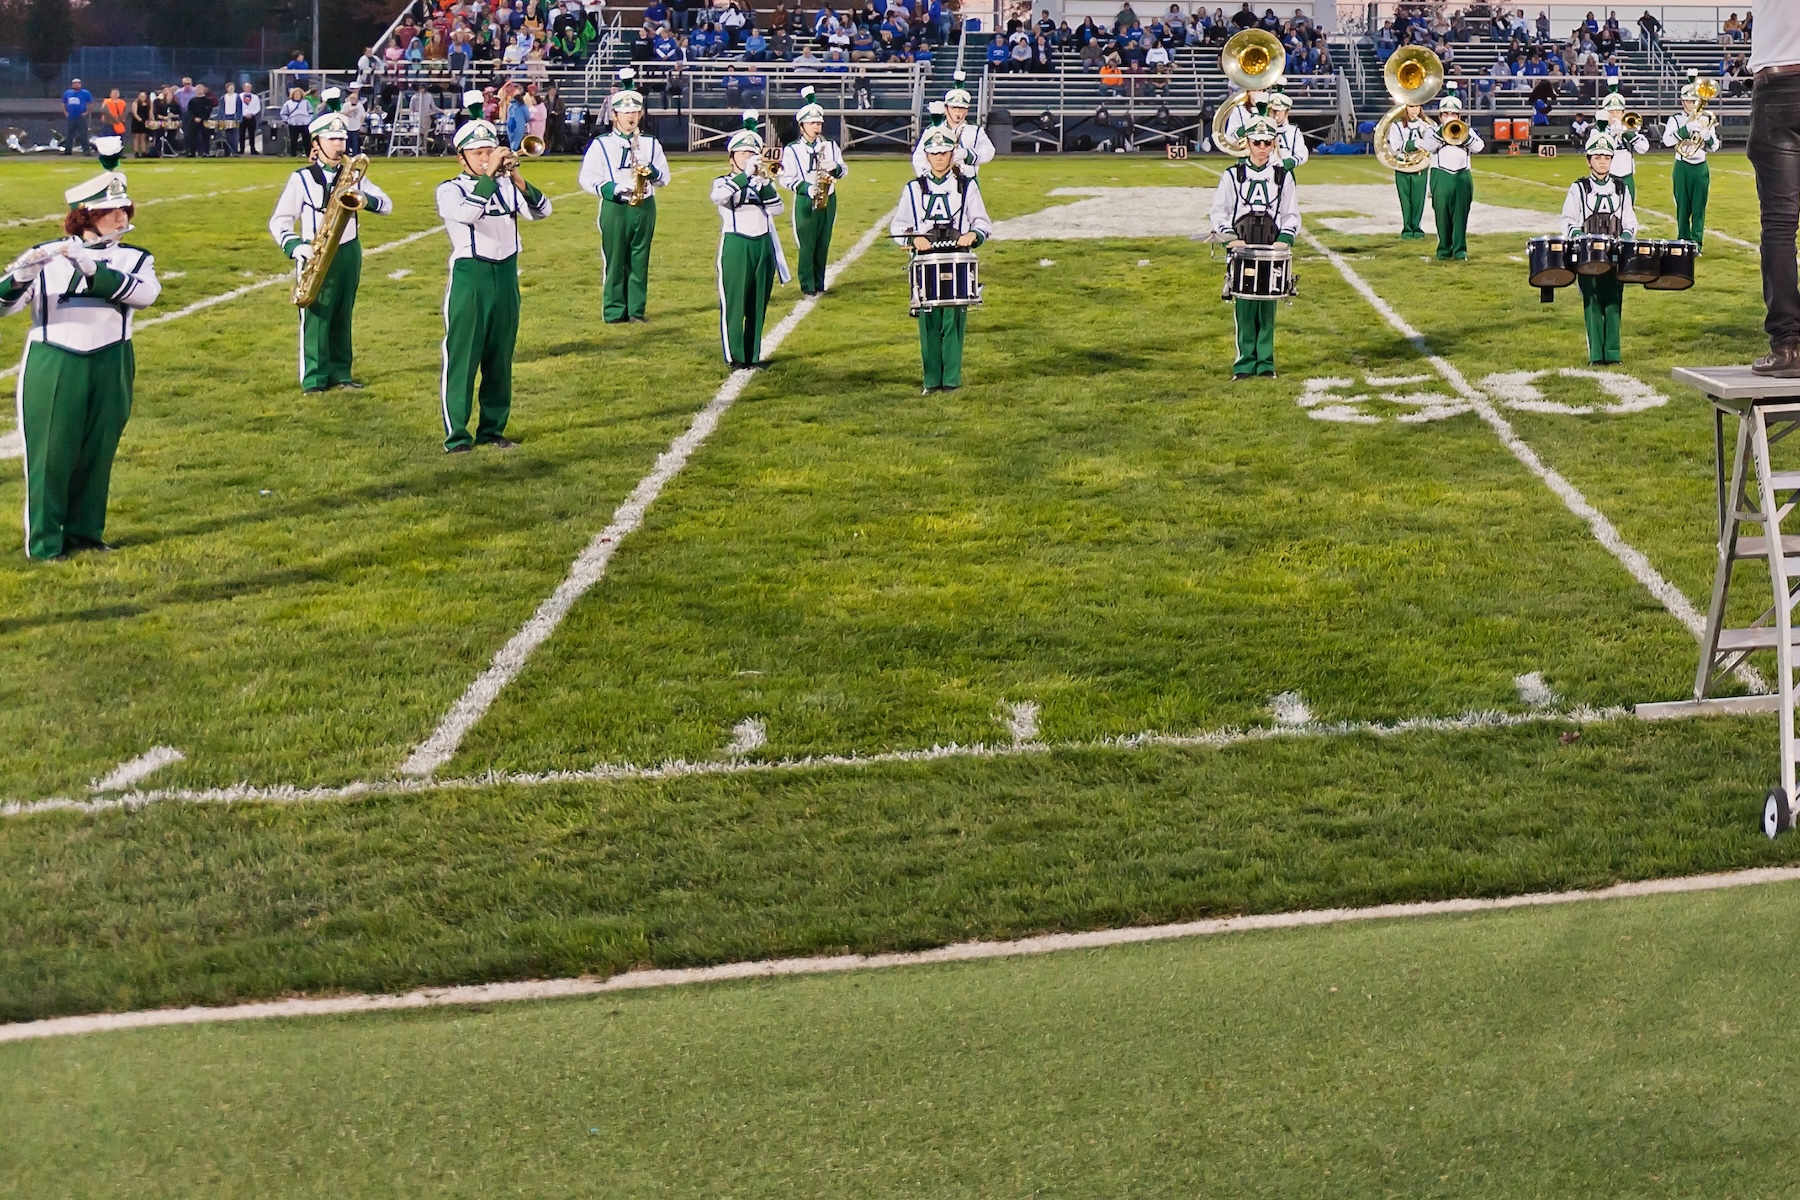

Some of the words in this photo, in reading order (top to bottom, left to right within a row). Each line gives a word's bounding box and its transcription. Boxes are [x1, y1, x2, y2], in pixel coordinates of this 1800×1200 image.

[1410, 129, 1421, 141] A
[763, 148, 781, 161] 40
[1170, 147, 1186, 159] 50
[1540, 146, 1555, 157] 40
[1248, 182, 1268, 205] A
[485, 192, 508, 215] A
[928, 195, 950, 220] A
[1597, 195, 1612, 214] A
[1298, 367, 1671, 423] 50
